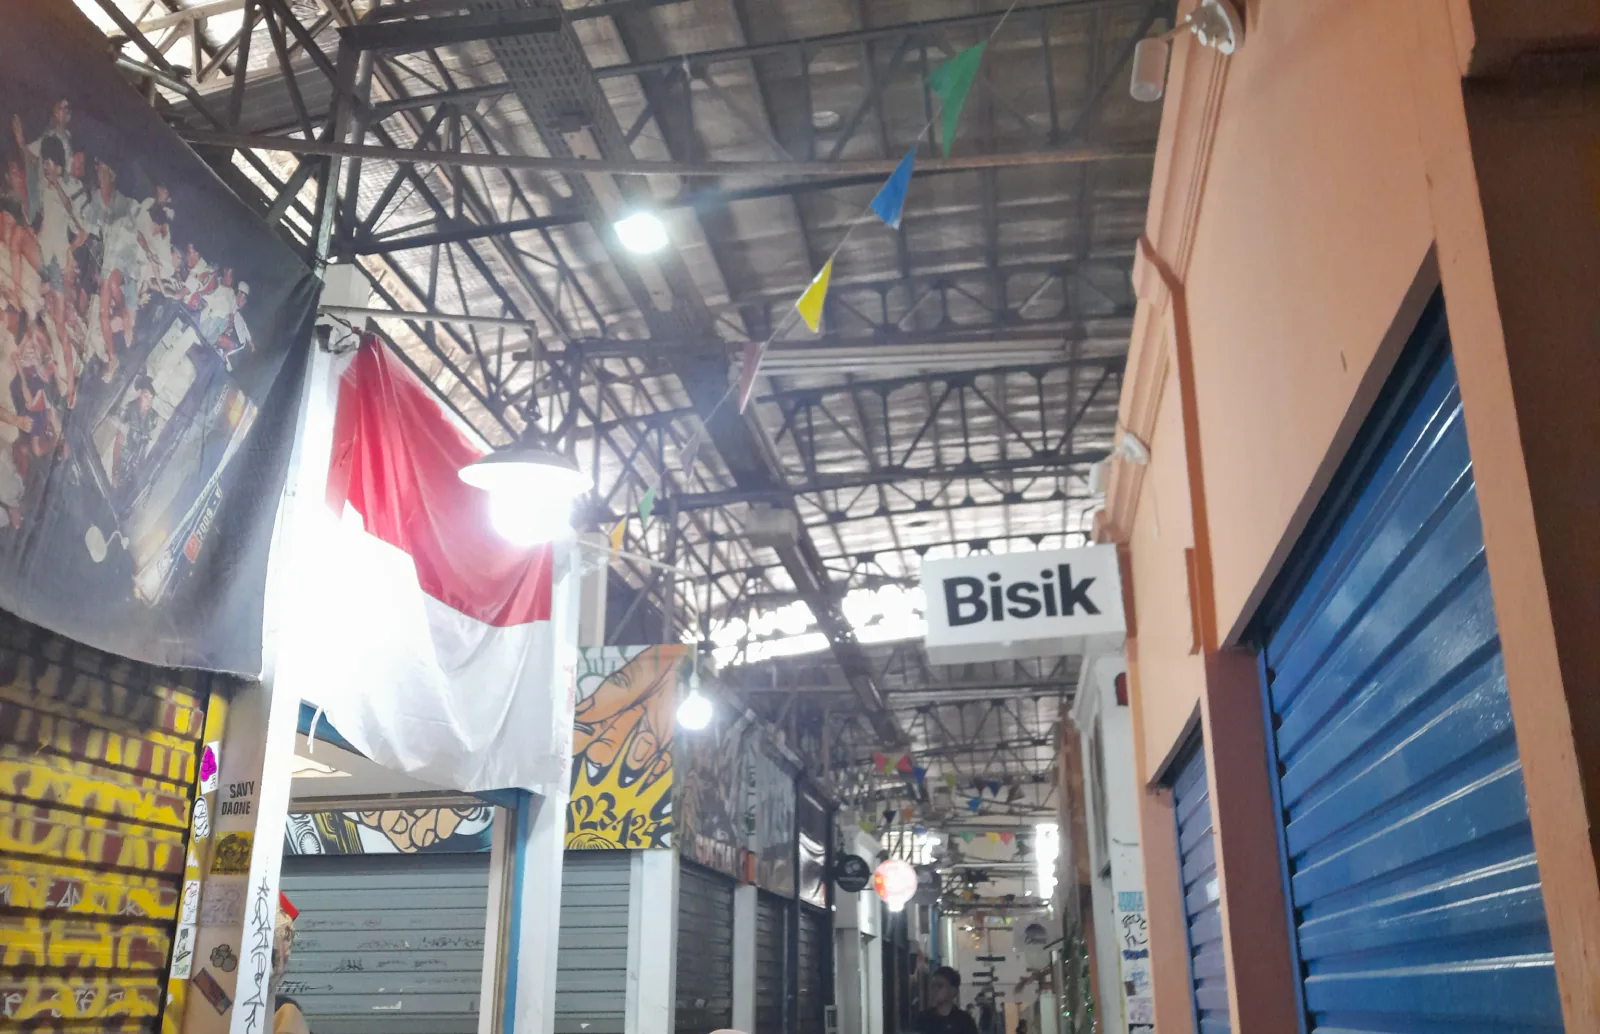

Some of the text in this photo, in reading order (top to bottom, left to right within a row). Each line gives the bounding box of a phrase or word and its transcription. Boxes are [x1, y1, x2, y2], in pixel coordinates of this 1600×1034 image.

[943, 563, 1102, 627] Bisik
[229, 781, 255, 799] SAVY
[221, 801, 251, 816] DAONE
